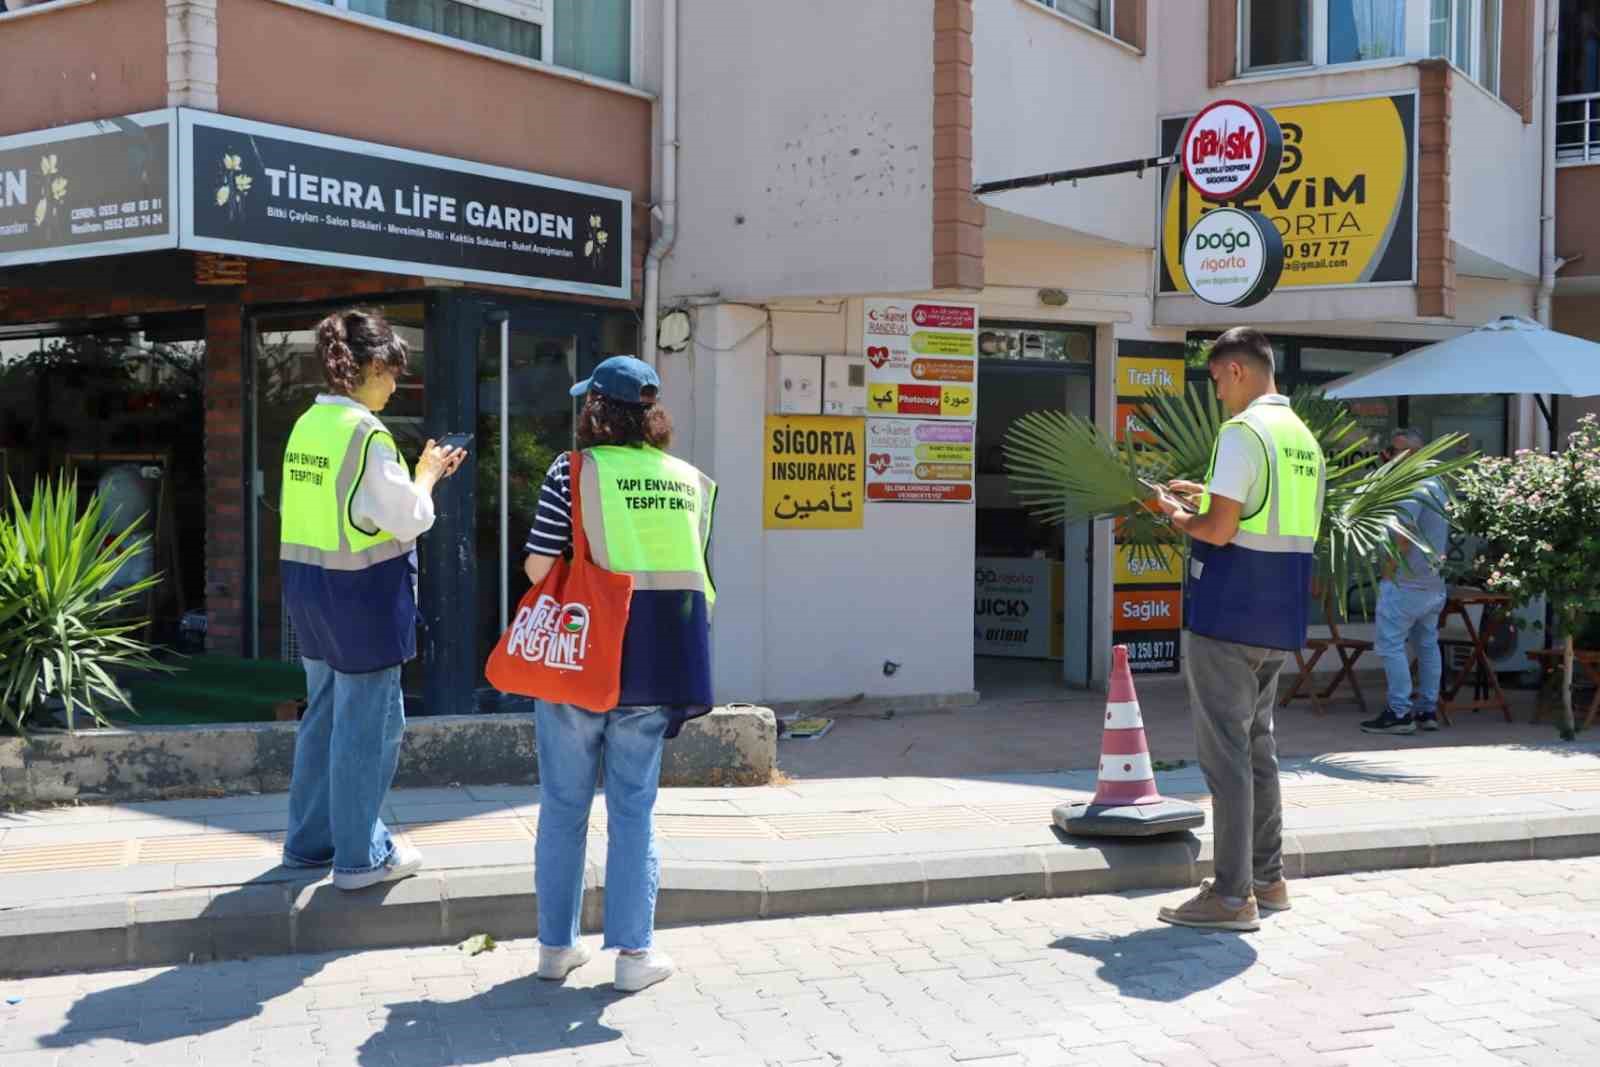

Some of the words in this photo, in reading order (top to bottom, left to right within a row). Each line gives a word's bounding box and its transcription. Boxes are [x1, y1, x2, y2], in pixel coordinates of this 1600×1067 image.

[264, 164, 385, 212] TİERRA
[395, 184, 457, 223] LİFE
[465, 200, 574, 240] GARDEN
[266, 206, 288, 219] Bitki
[289, 209, 319, 224] Çayları
[326, 215, 350, 228] Salon
[351, 218, 382, 232] Bitkileri
[1300, 241, 1321, 258] 97
[1328, 240, 1349, 256] 77
[1127, 367, 1173, 386] Trafik
[772, 423, 856, 456] SİGORTA
[772, 461, 856, 481] INSURANCE
[616, 478, 641, 491] YAPI
[625, 495, 666, 510] TESPİT
[774, 485, 853, 520] تأمين
[1122, 600, 1171, 622] Sağlık
